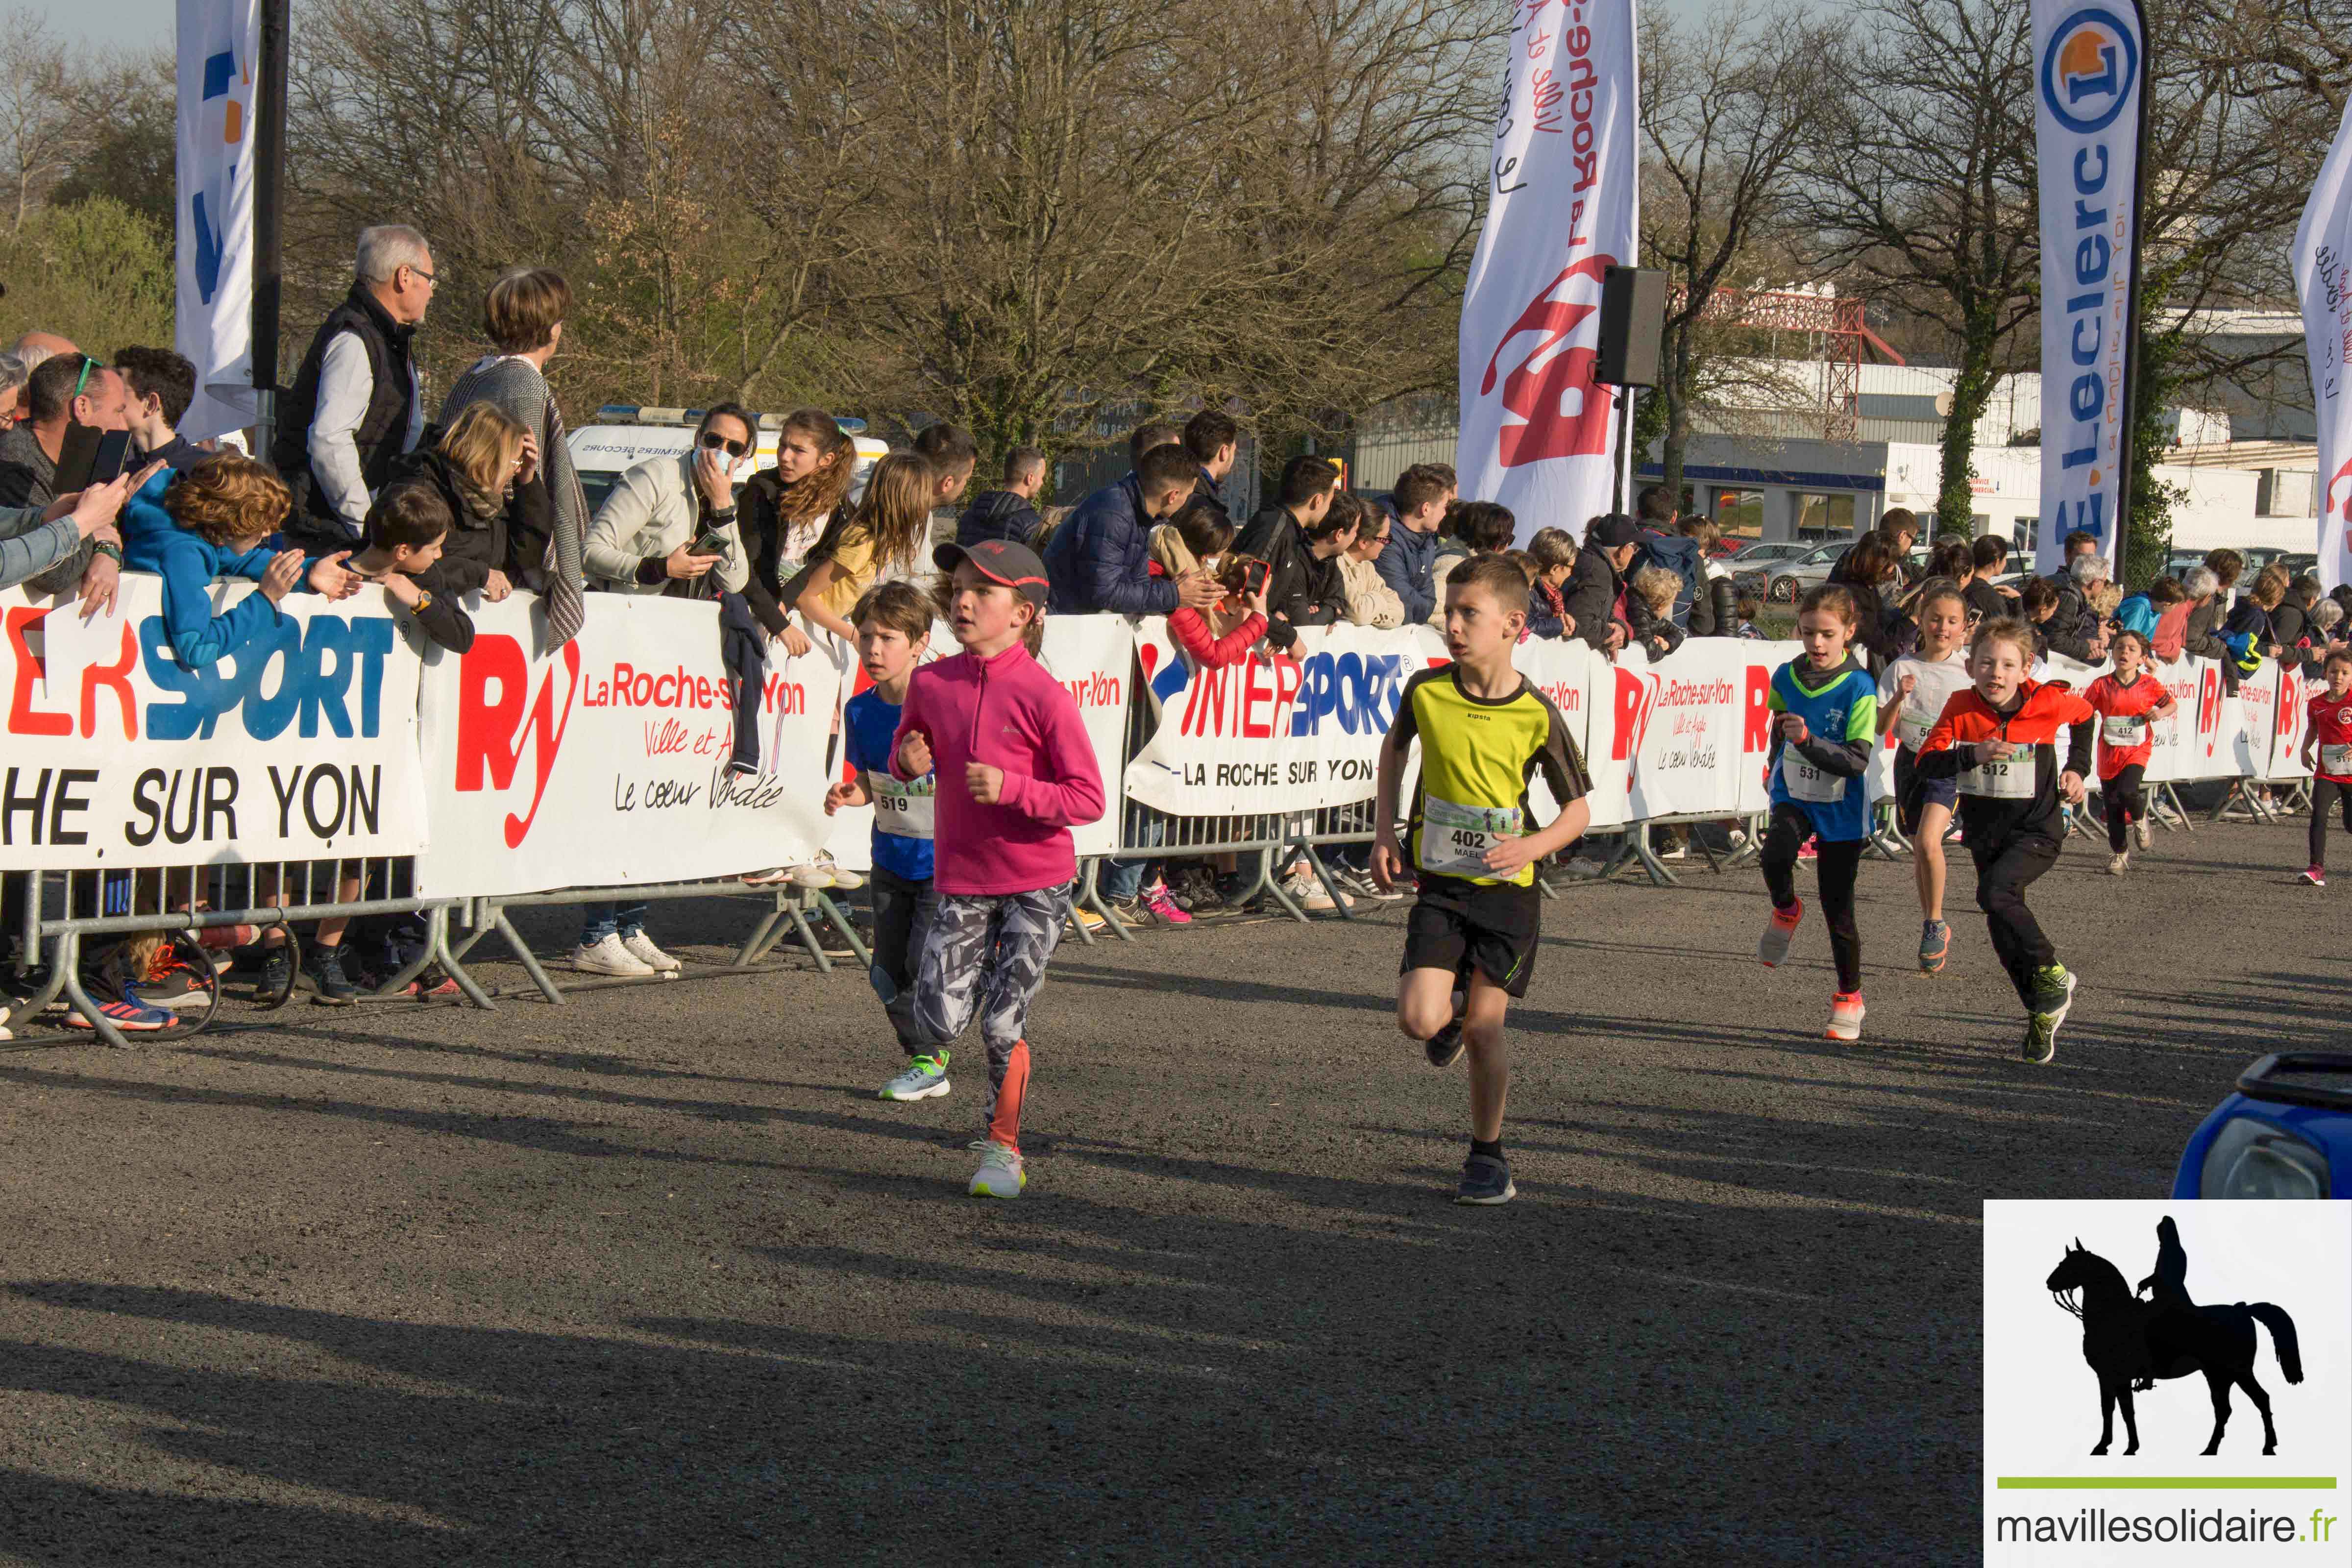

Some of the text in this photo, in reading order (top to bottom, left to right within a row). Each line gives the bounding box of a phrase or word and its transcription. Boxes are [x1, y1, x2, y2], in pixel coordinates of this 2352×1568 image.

[584, 673, 609, 707] La
[1180, 651, 1402, 738] INTERSPORT
[1658, 678, 1734, 707] La Roche-sur-Yon
[645, 717, 688, 759] Ville
[693, 726, 716, 754] et
[1184, 759, 1373, 787] LA ROCHE SUR YON
[1800, 765, 1820, 781] 531
[1983, 764, 2008, 776] 512
[615, 773, 636, 811] Le
[709, 765, 784, 810] Vendée
[124, 766, 239, 847] SUR
[267, 763, 382, 840] YON
[881, 795, 908, 811] 519
[1451, 830, 1486, 849] 402
[1455, 848, 1481, 859] MAEL
